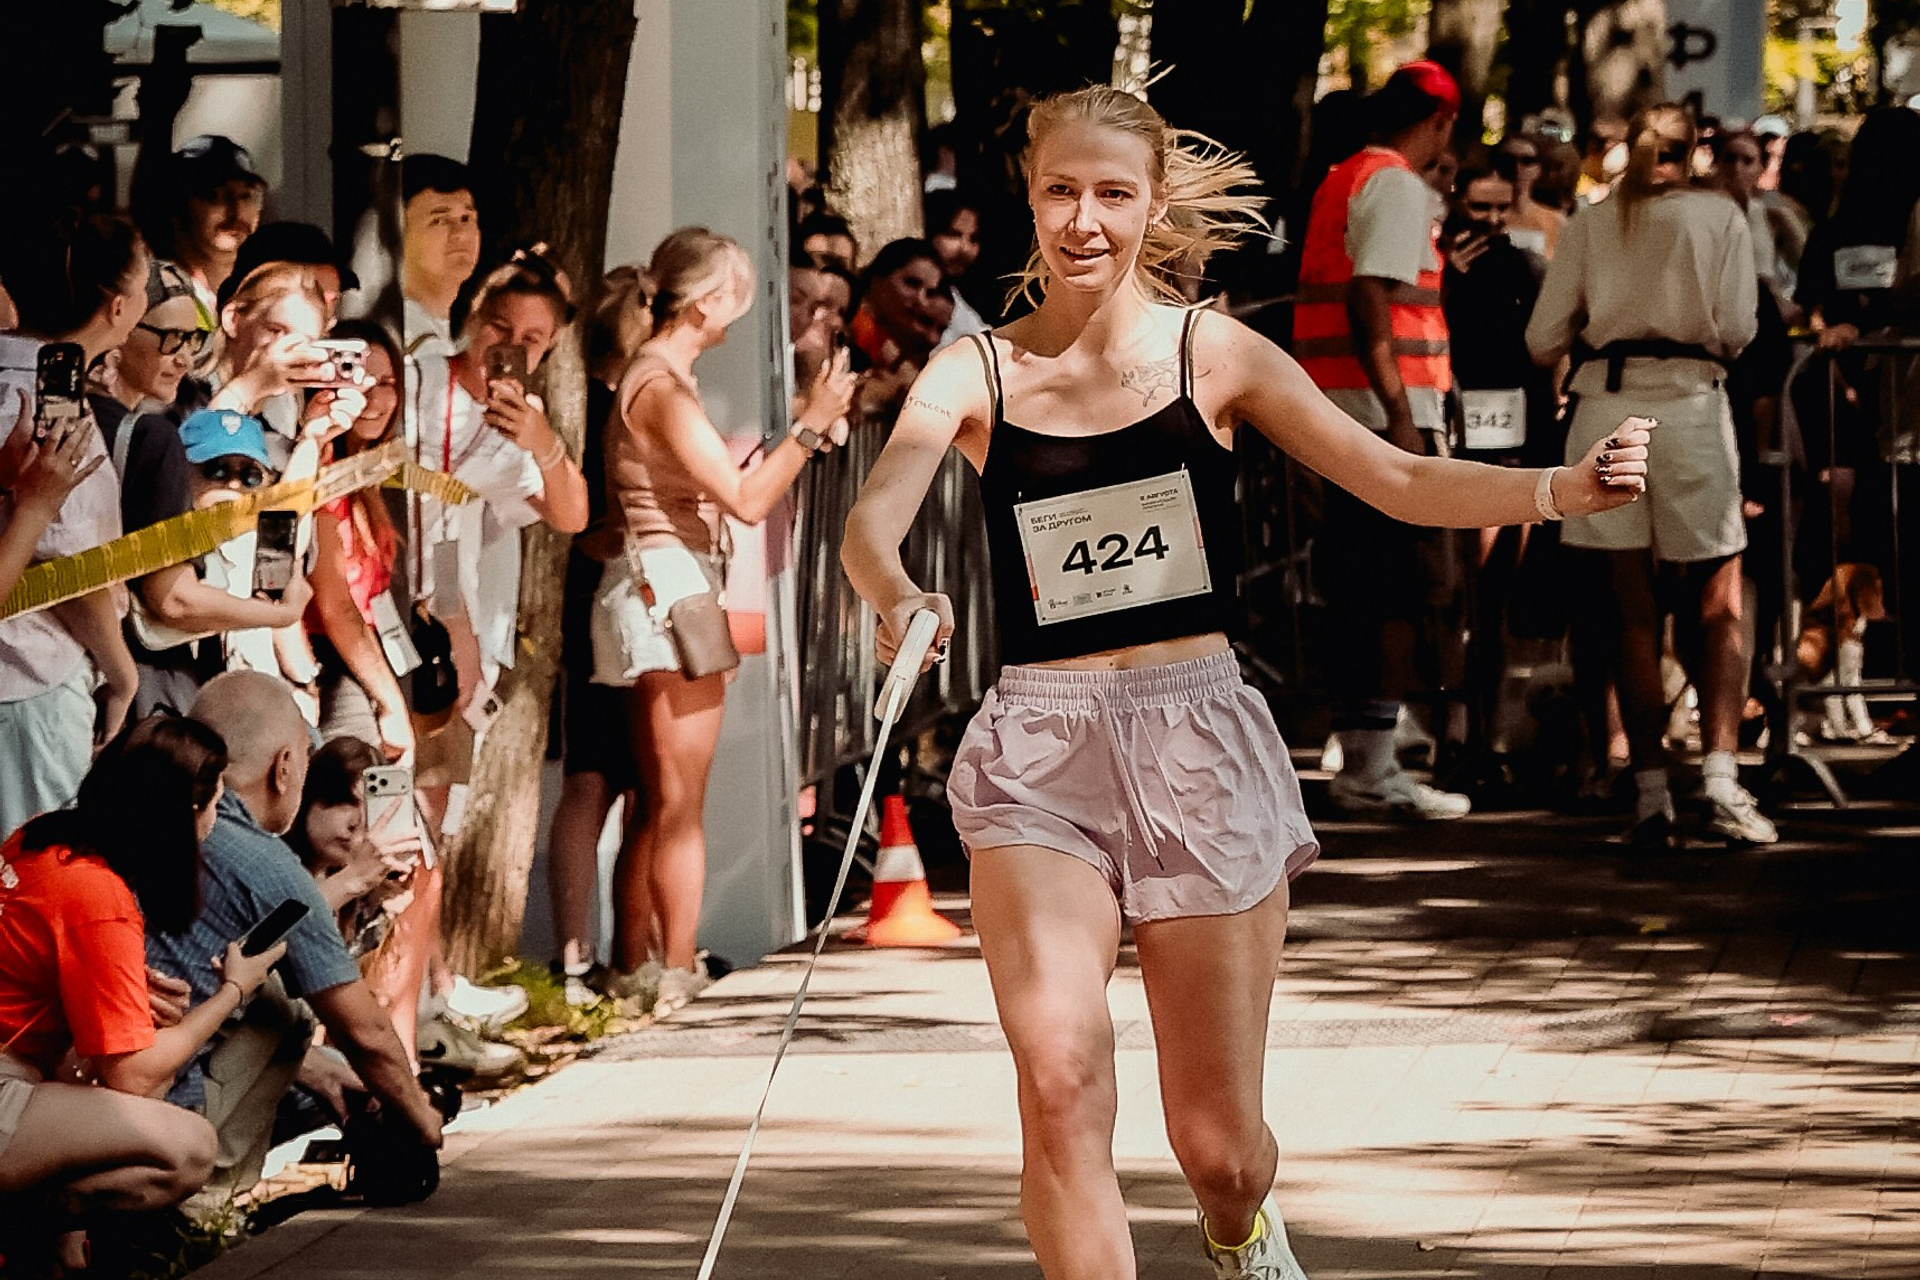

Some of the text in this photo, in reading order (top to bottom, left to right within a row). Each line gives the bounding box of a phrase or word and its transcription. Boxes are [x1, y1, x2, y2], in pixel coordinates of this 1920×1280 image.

[1466, 409, 1513, 430] 342
[1030, 513, 1057, 525] БЕГИ
[1032, 514, 1092, 533] ЗА ДРУГОМ
[1062, 525, 1170, 575] 424
